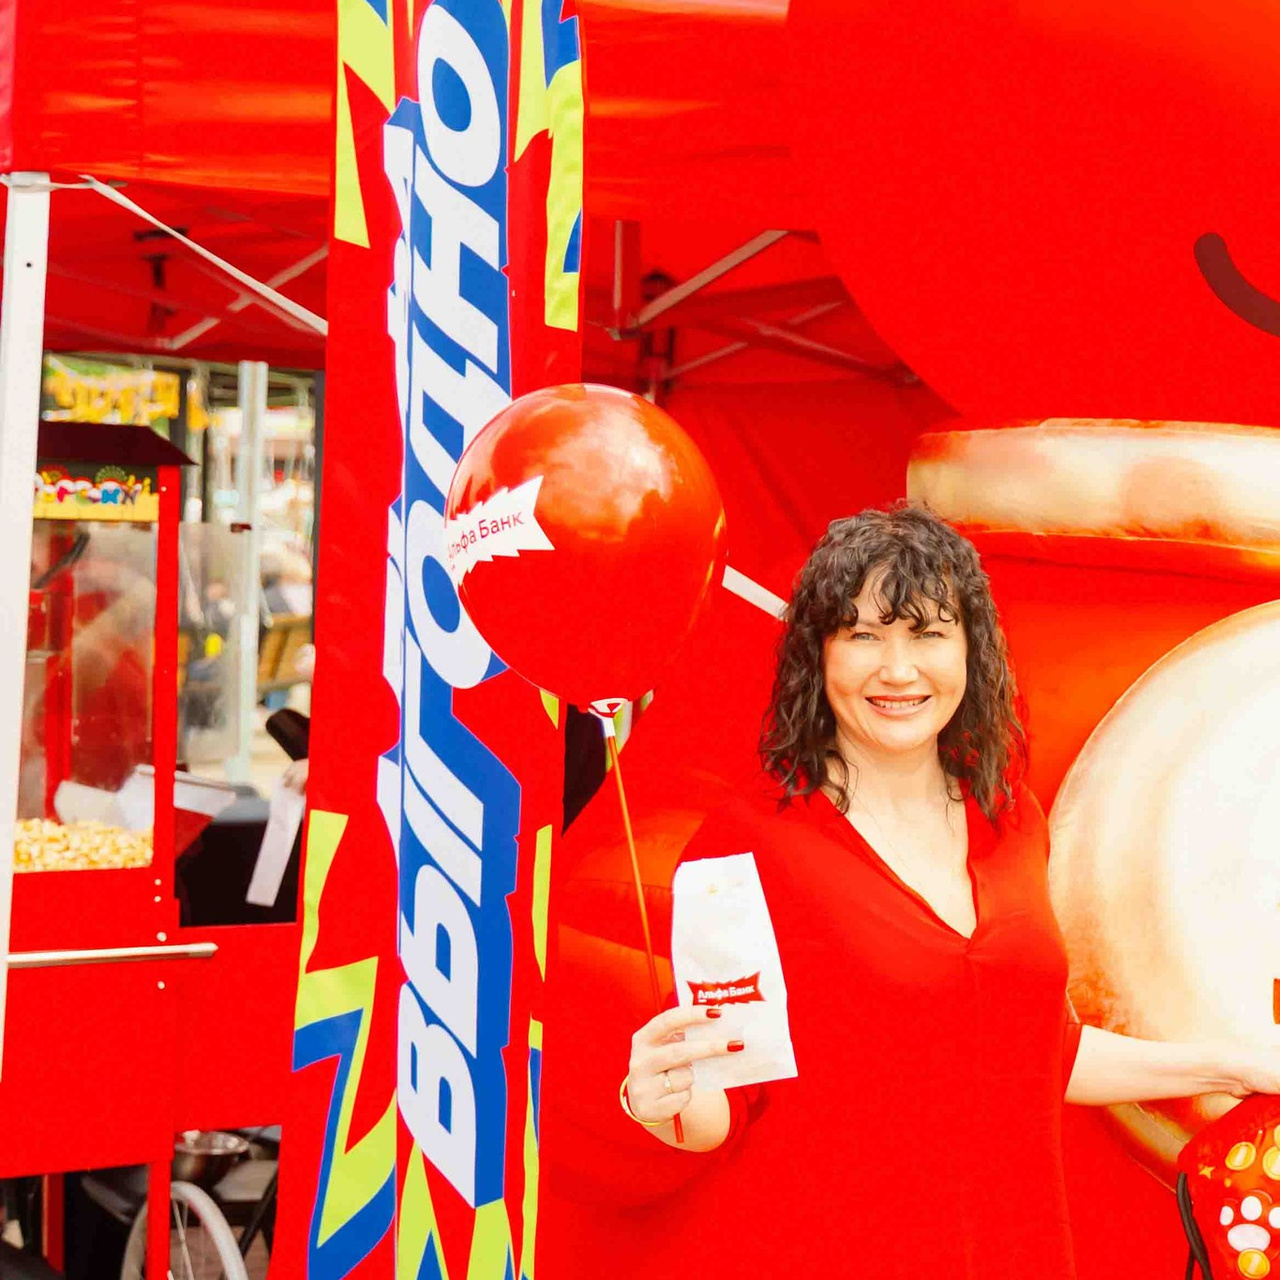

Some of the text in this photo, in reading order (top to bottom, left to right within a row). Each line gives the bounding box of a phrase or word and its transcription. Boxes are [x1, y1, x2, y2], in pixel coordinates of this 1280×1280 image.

[478, 511, 525, 539] Банк
[397, 4, 512, 1209] ВЫГОДНО
[728, 985, 755, 997] Банк
